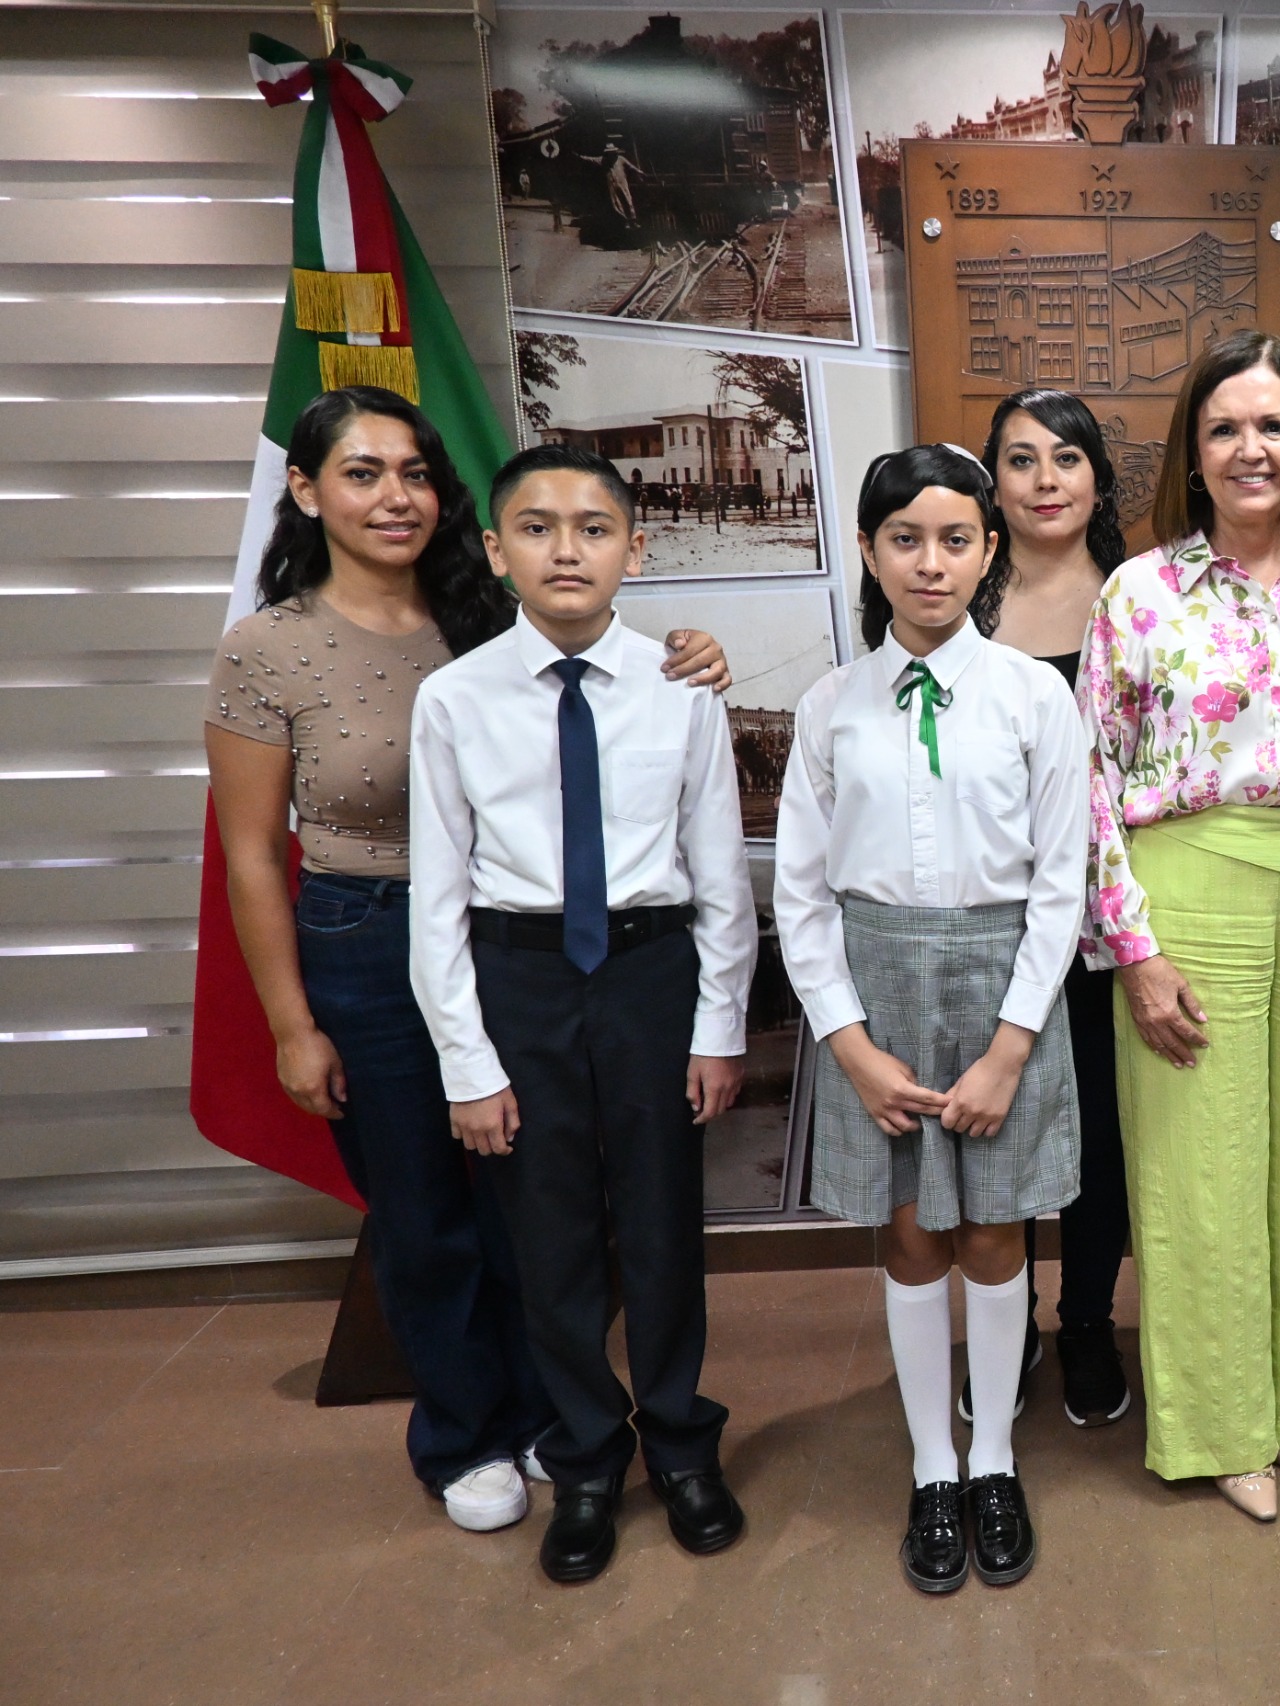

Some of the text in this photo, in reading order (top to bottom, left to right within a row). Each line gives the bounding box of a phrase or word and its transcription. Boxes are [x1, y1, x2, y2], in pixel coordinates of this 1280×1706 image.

[946, 187, 1262, 212] 1893 1927 1965
